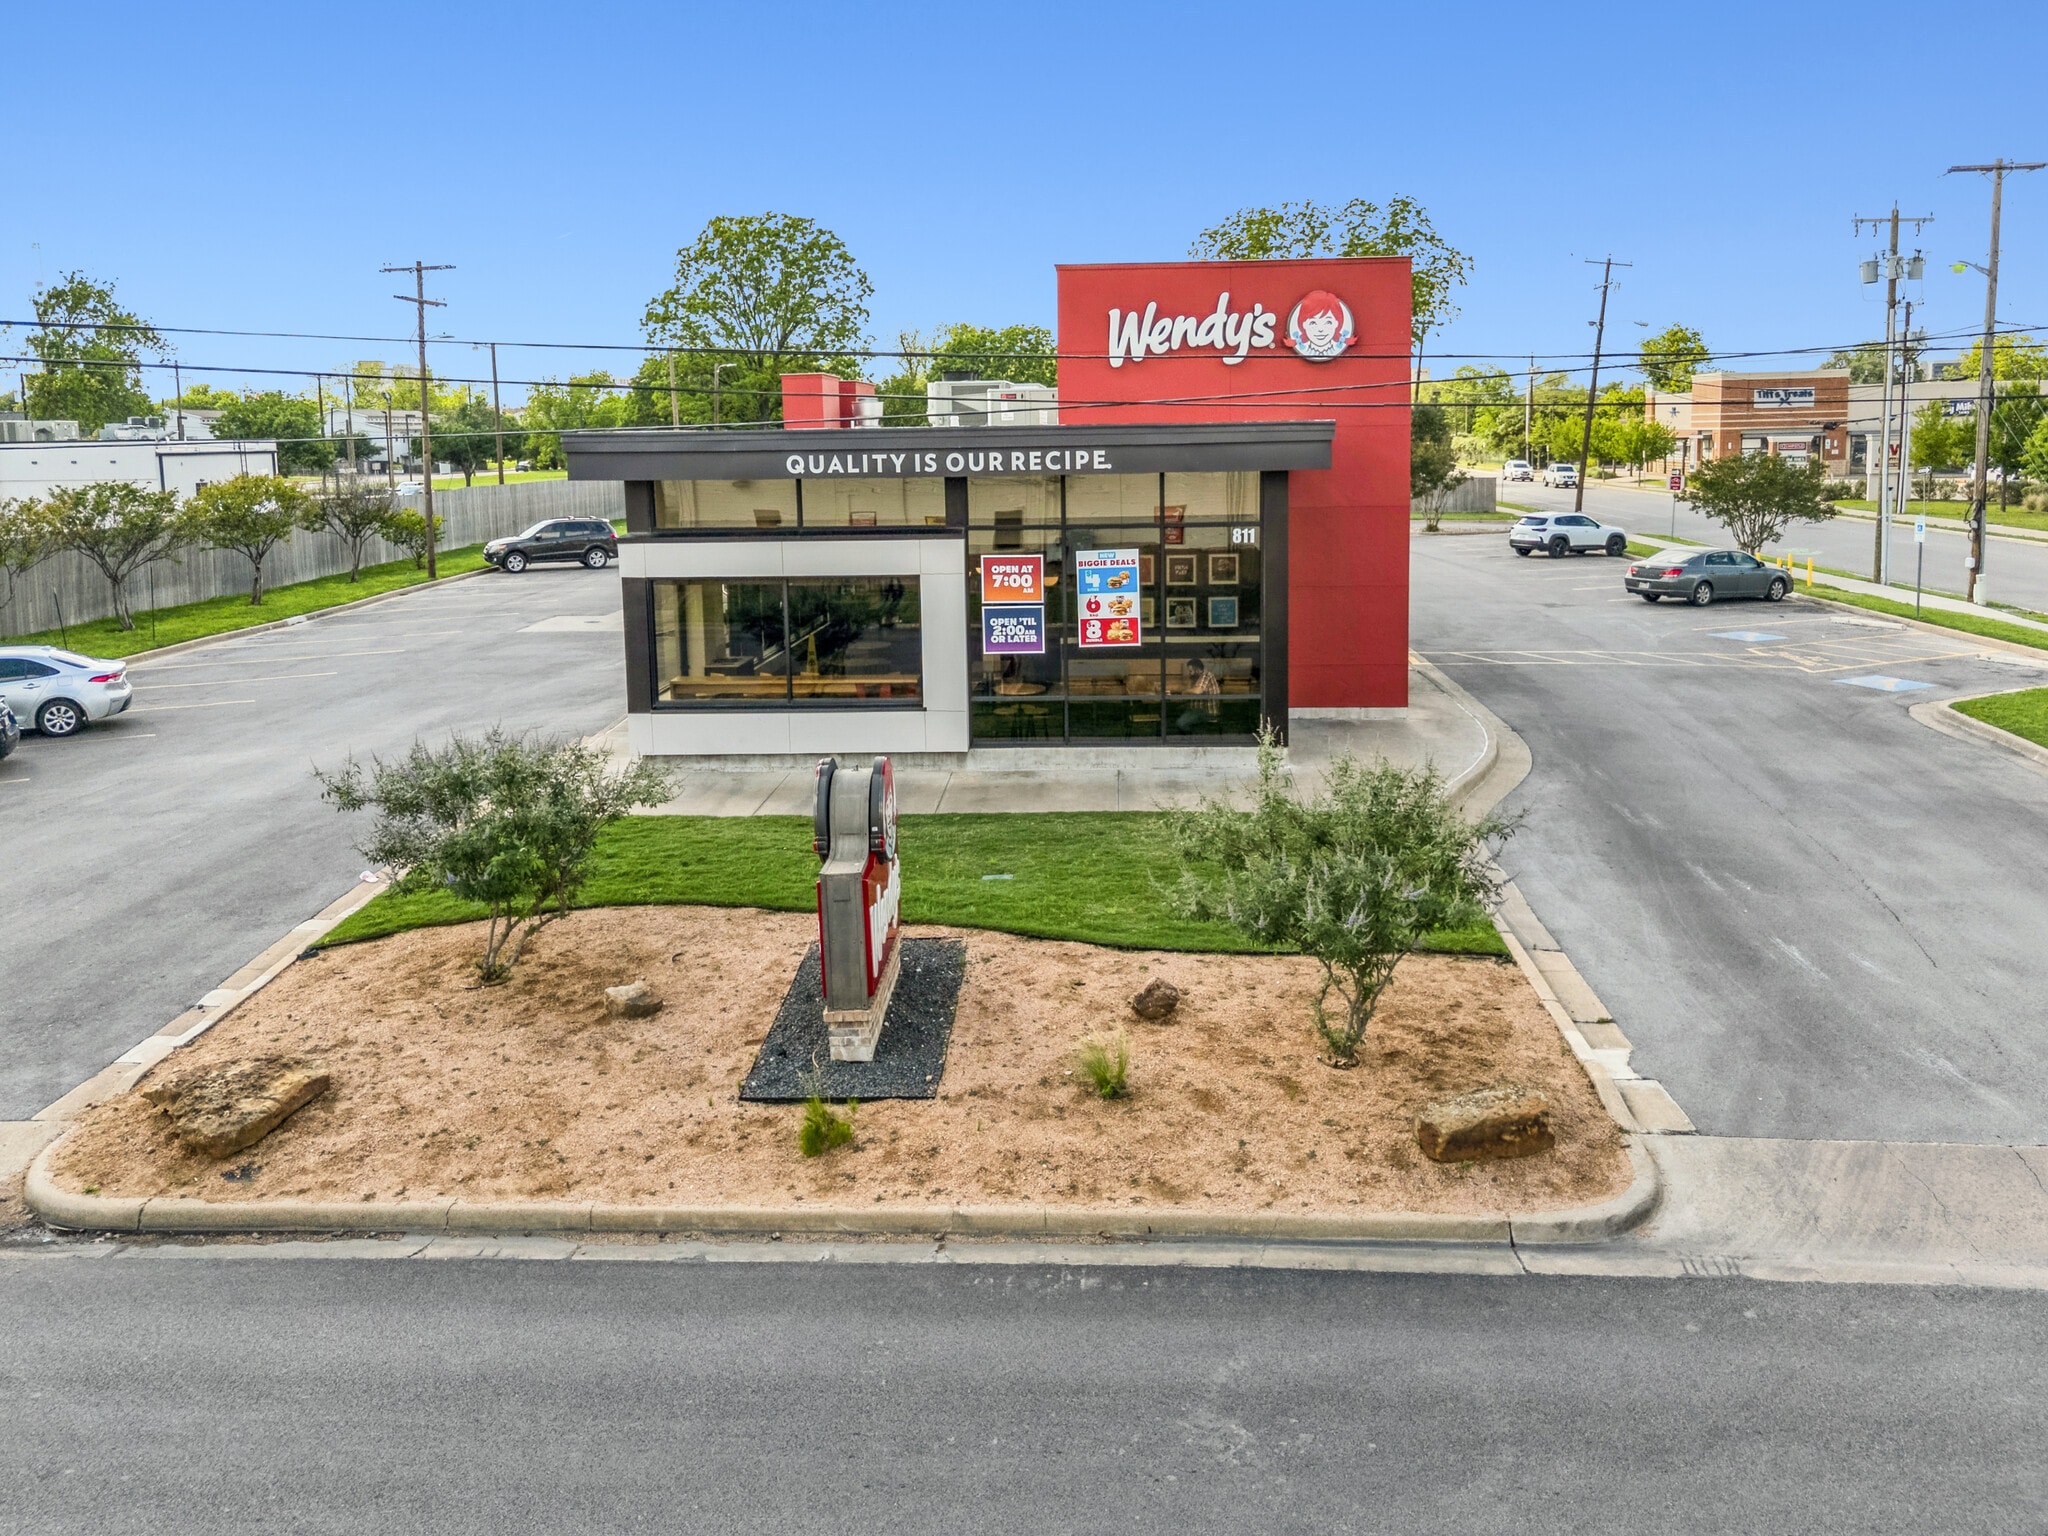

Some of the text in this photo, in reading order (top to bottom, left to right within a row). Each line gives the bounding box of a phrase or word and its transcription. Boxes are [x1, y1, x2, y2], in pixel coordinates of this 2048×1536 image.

[1108, 291, 1276, 368] Wendy's
[786, 450, 1112, 474] QUALITY IS OUR RECIPE.
[1232, 528, 1255, 543] 811
[991, 565, 1034, 573] OPEN AT
[992, 574, 1033, 588] 7:00
[990, 618, 1017, 626] OPEN
[991, 635, 1037, 643] OR LATER
